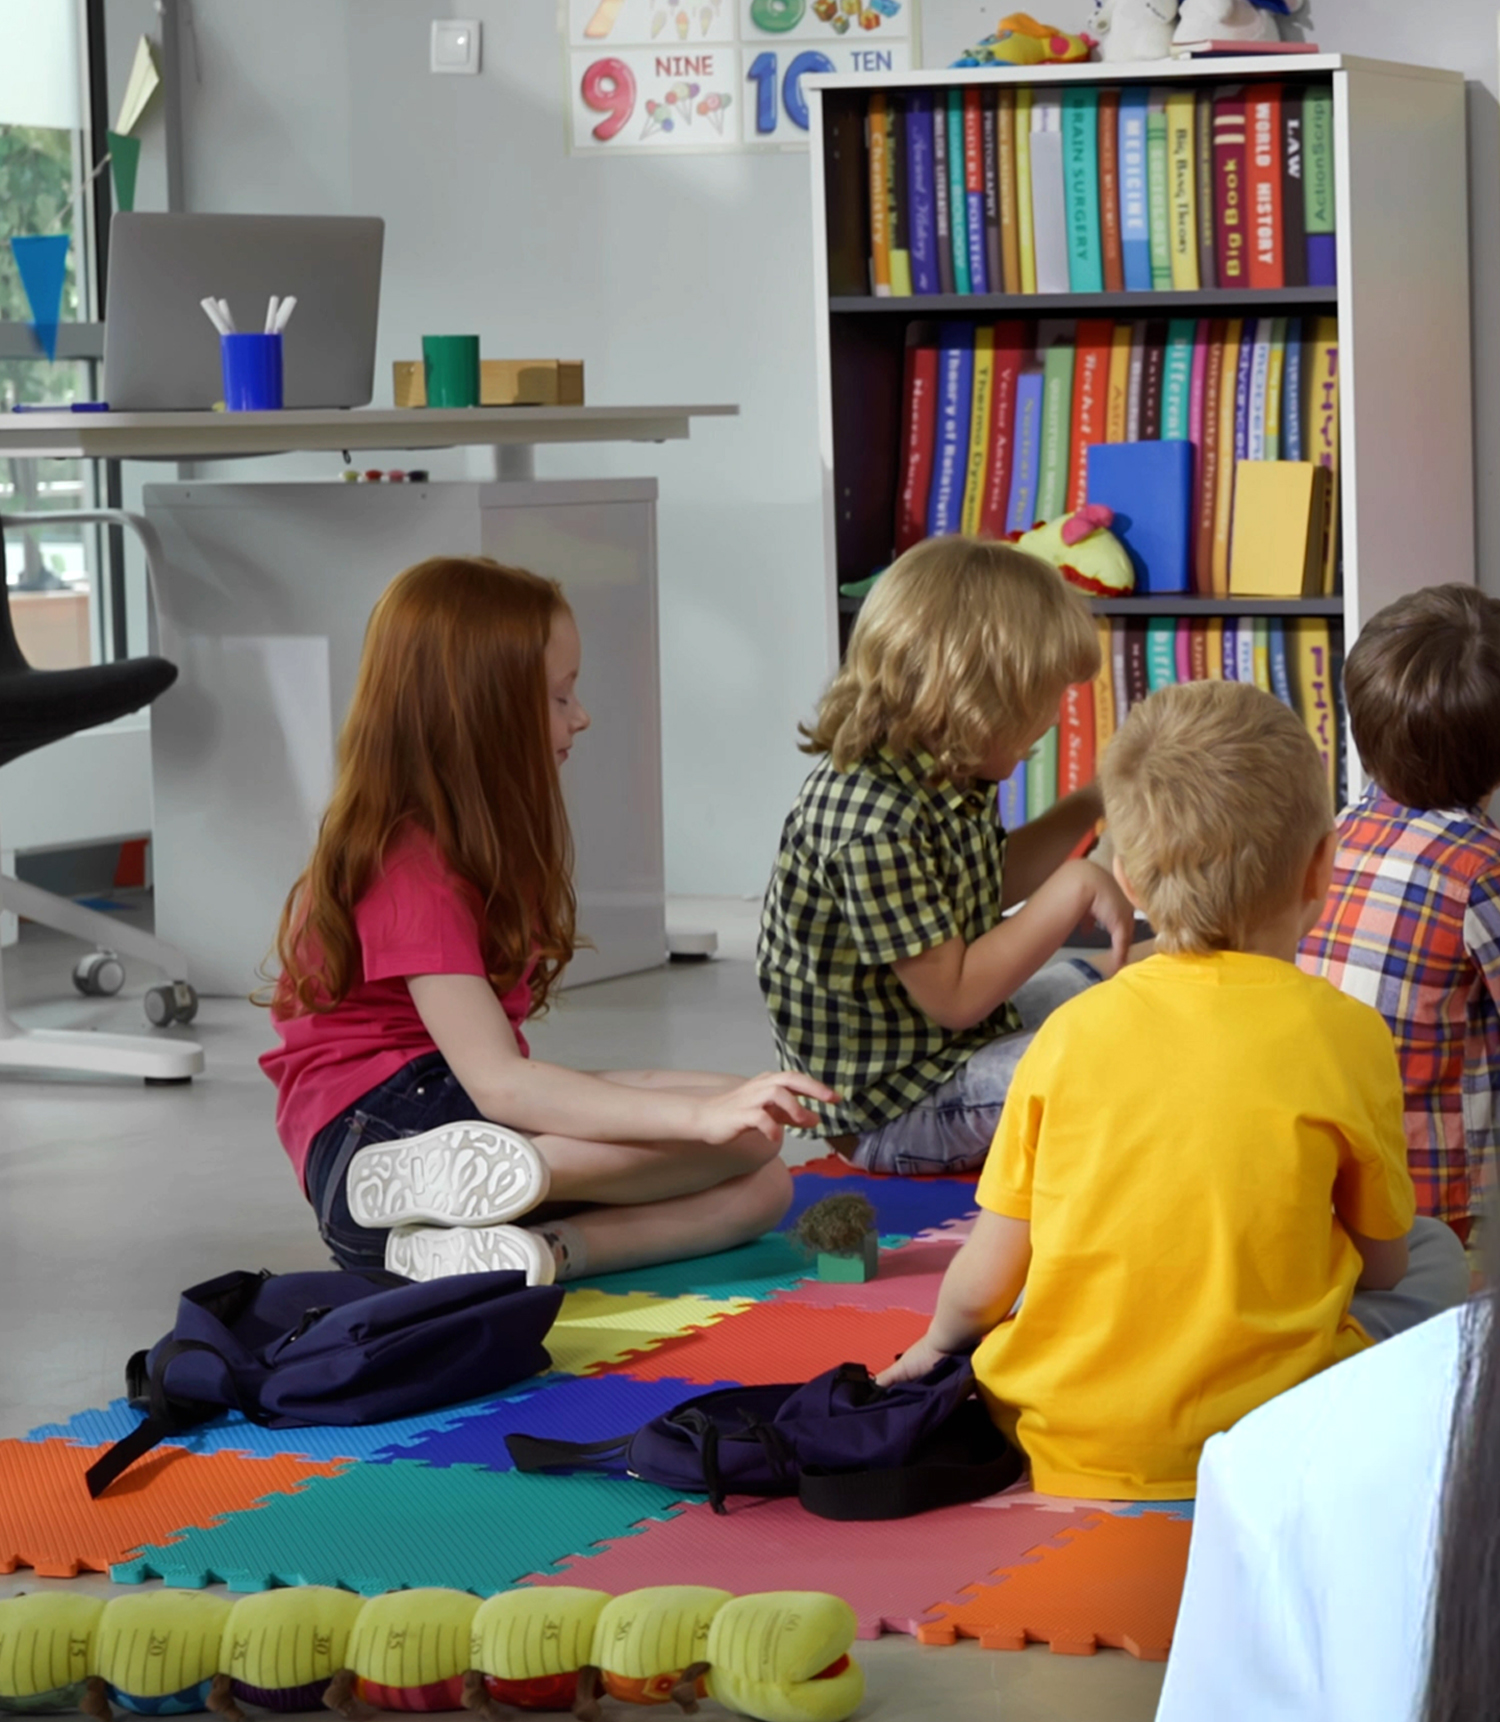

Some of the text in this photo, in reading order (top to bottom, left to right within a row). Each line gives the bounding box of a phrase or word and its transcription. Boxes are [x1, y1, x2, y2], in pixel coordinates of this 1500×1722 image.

[581, 56, 713, 141] 9 NINE
[850, 51, 892, 71] TEN
[870, 131, 886, 246] Chemistry
[937, 165, 949, 236] LITERATURE
[984, 110, 997, 219] PHOTOGRAPHY
[1071, 99, 1088, 261] BRAIN SURGERY
[1125, 119, 1143, 230] MEDICINE
[1254, 102, 1274, 265] WORLD HISTORY
[1286, 119, 1301, 178] LAW
[969, 195, 984, 285] POLITICS
[1151, 149, 1166, 256] SOCIOLOGY
[1222, 157, 1242, 277] Big Book
[933, 348, 961, 536] Theory of Relativity
[974, 365, 988, 446] Thermo
[990, 368, 1011, 511] Vector Analysis
[1202, 343, 1221, 529] University Physics
[71, 1637, 87, 1658] 15
[151, 1634, 167, 1657] 20
[314, 1632, 331, 1656] 30
